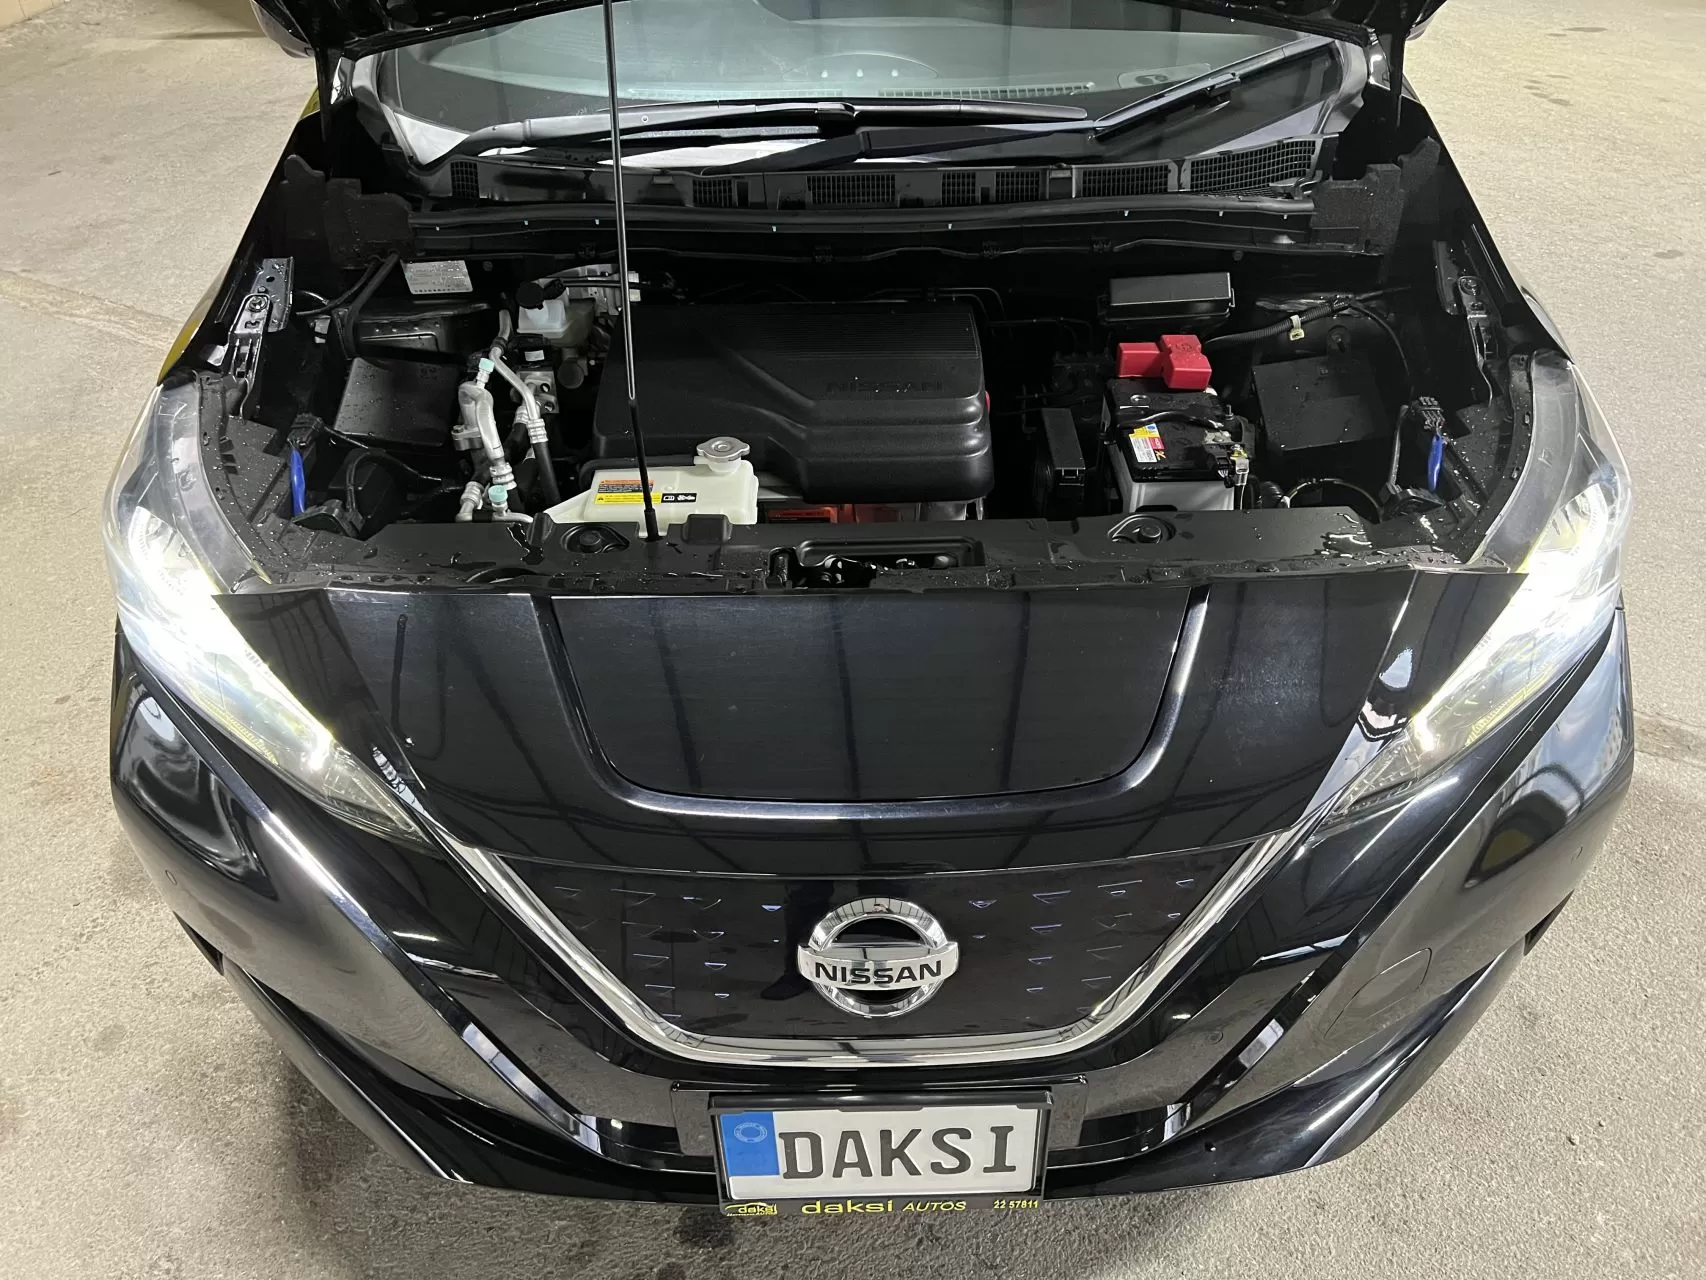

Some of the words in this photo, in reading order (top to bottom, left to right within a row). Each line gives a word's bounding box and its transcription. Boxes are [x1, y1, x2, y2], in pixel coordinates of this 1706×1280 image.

[826, 381, 943, 392] NISSAN
[815, 960, 941, 985] NISSAN
[779, 1125, 1016, 1180] DAKSI
[801, 1200, 893, 1214] daksi
[902, 1201, 966, 1212] AUTOS
[993, 1200, 1006, 1209] 22
[1008, 1199, 1038, 1209] 57811
